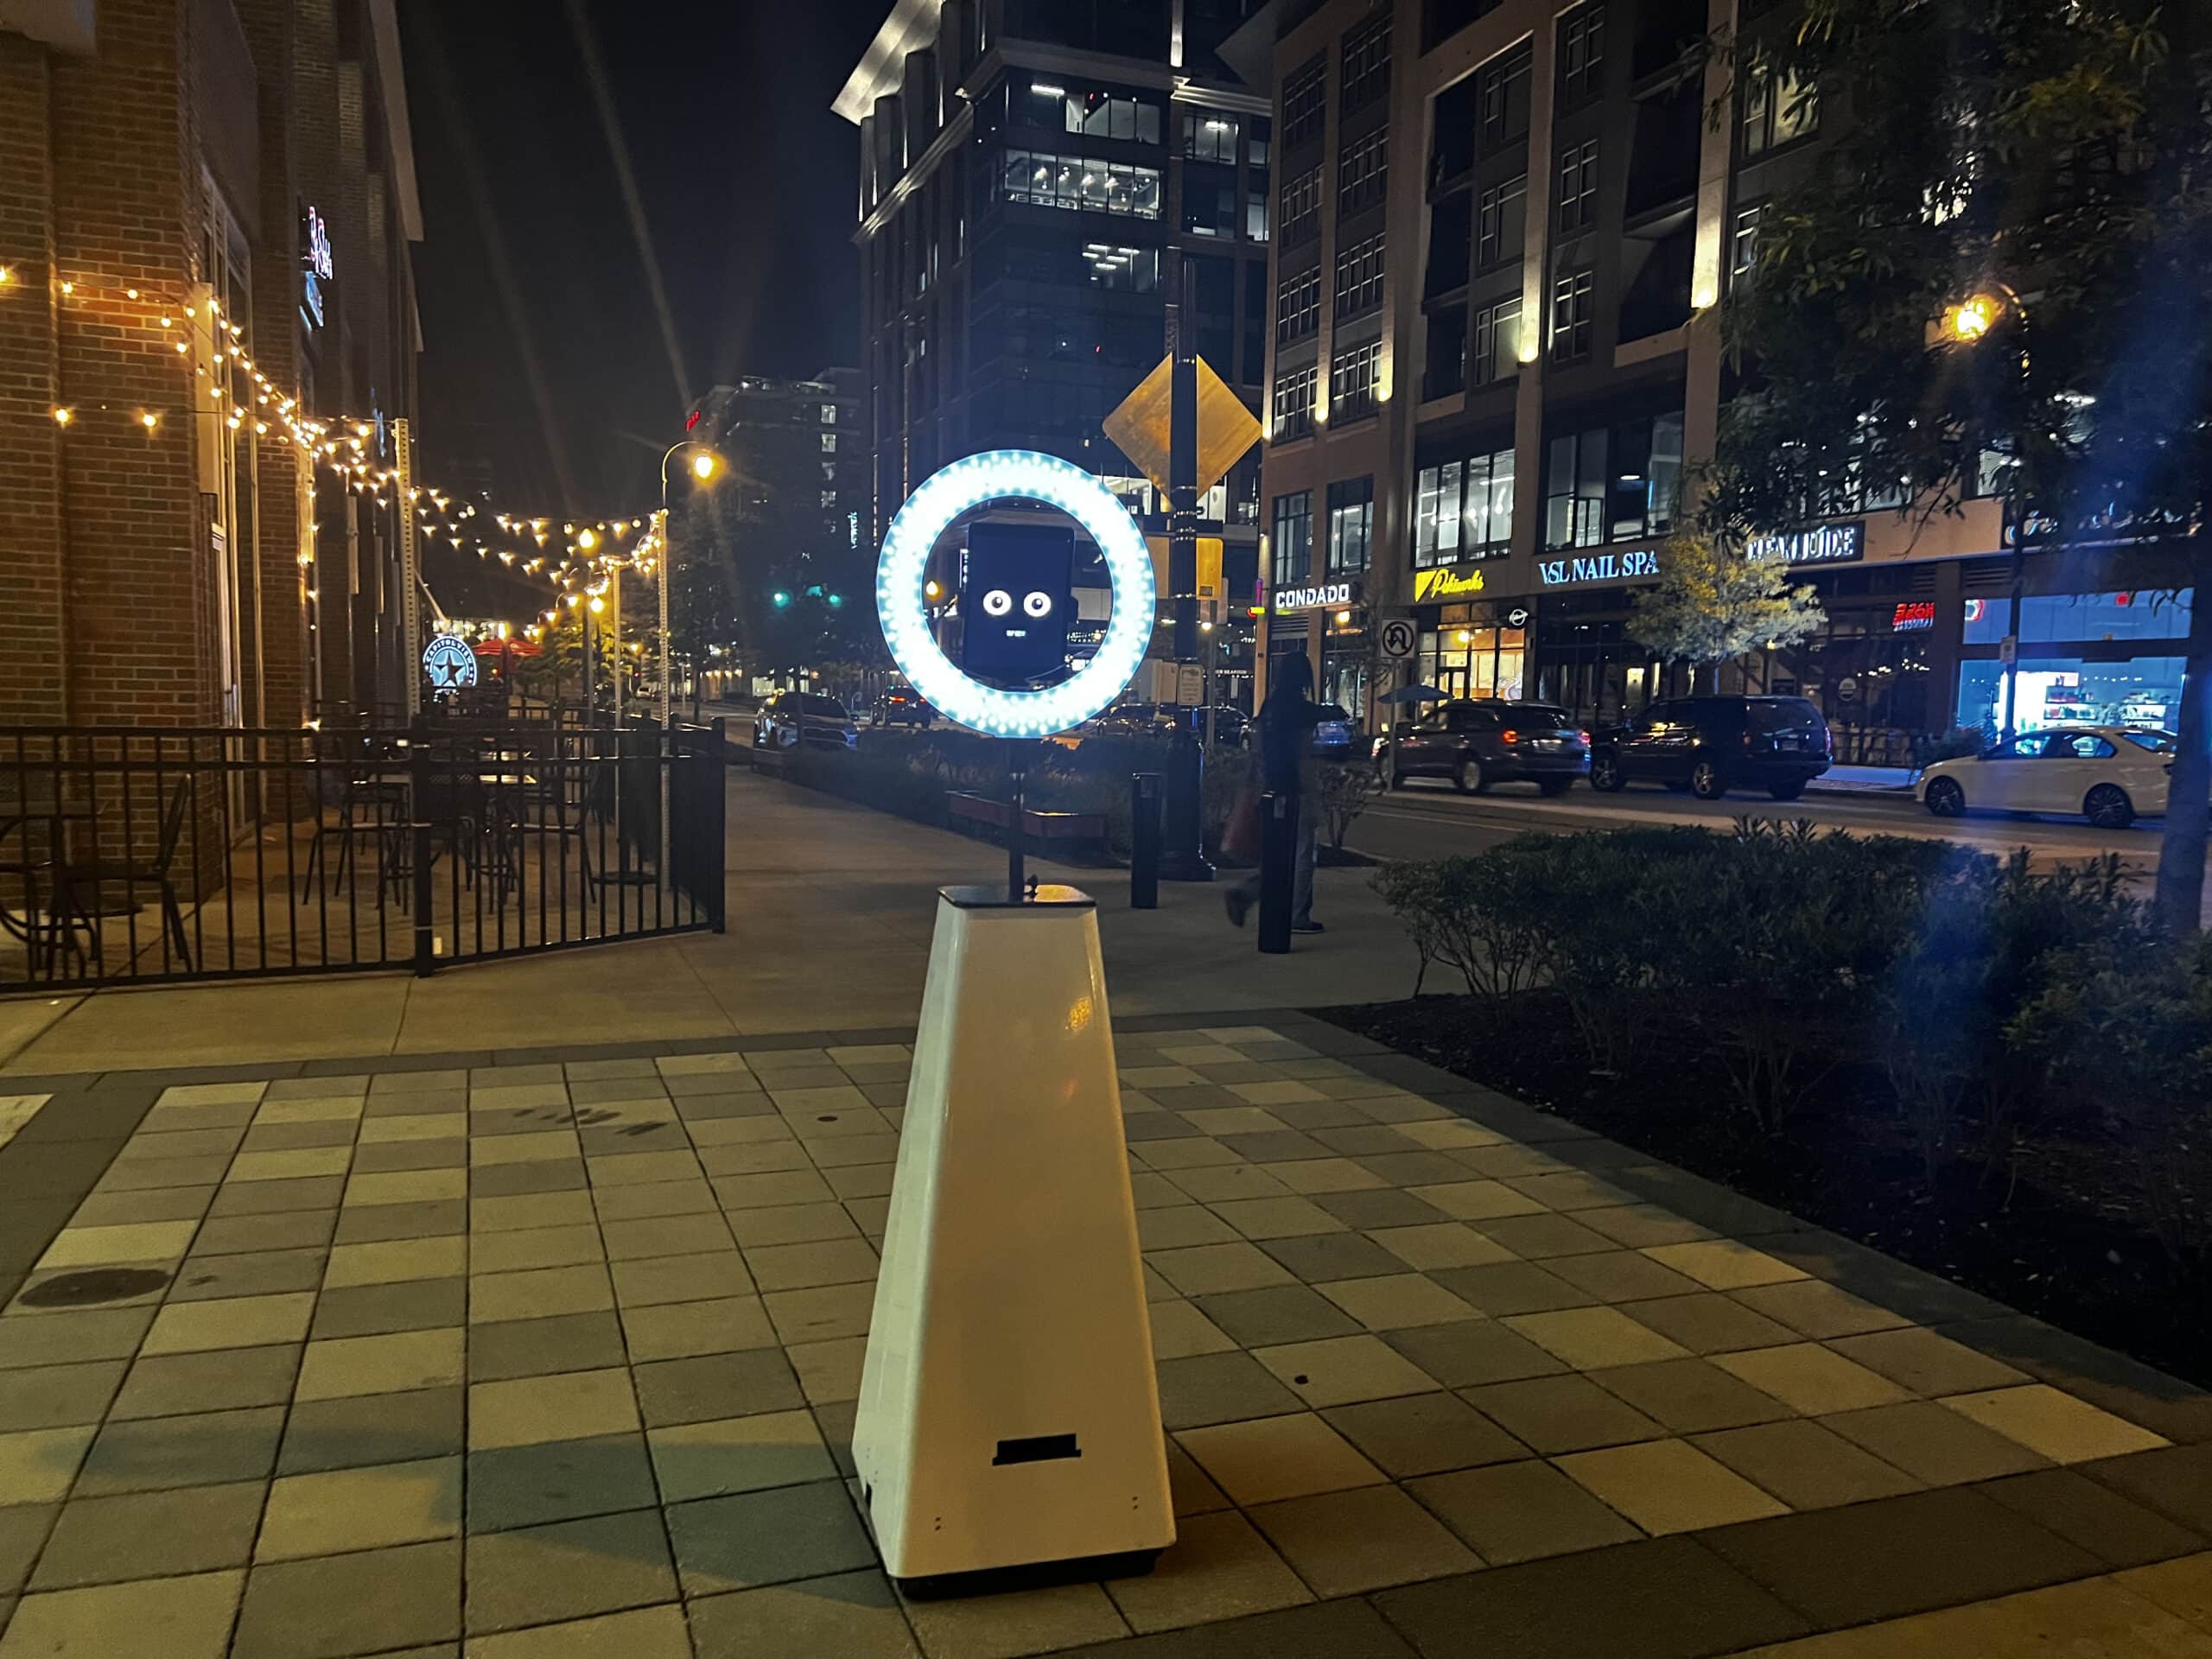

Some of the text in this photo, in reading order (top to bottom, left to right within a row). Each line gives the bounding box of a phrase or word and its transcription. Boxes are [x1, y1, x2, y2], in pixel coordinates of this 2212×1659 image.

[1538, 550, 1660, 585] VSL NAIL SPA
[1275, 583, 1350, 608] CONDADO
[426, 639, 473, 664] CAPITOL VIEW
